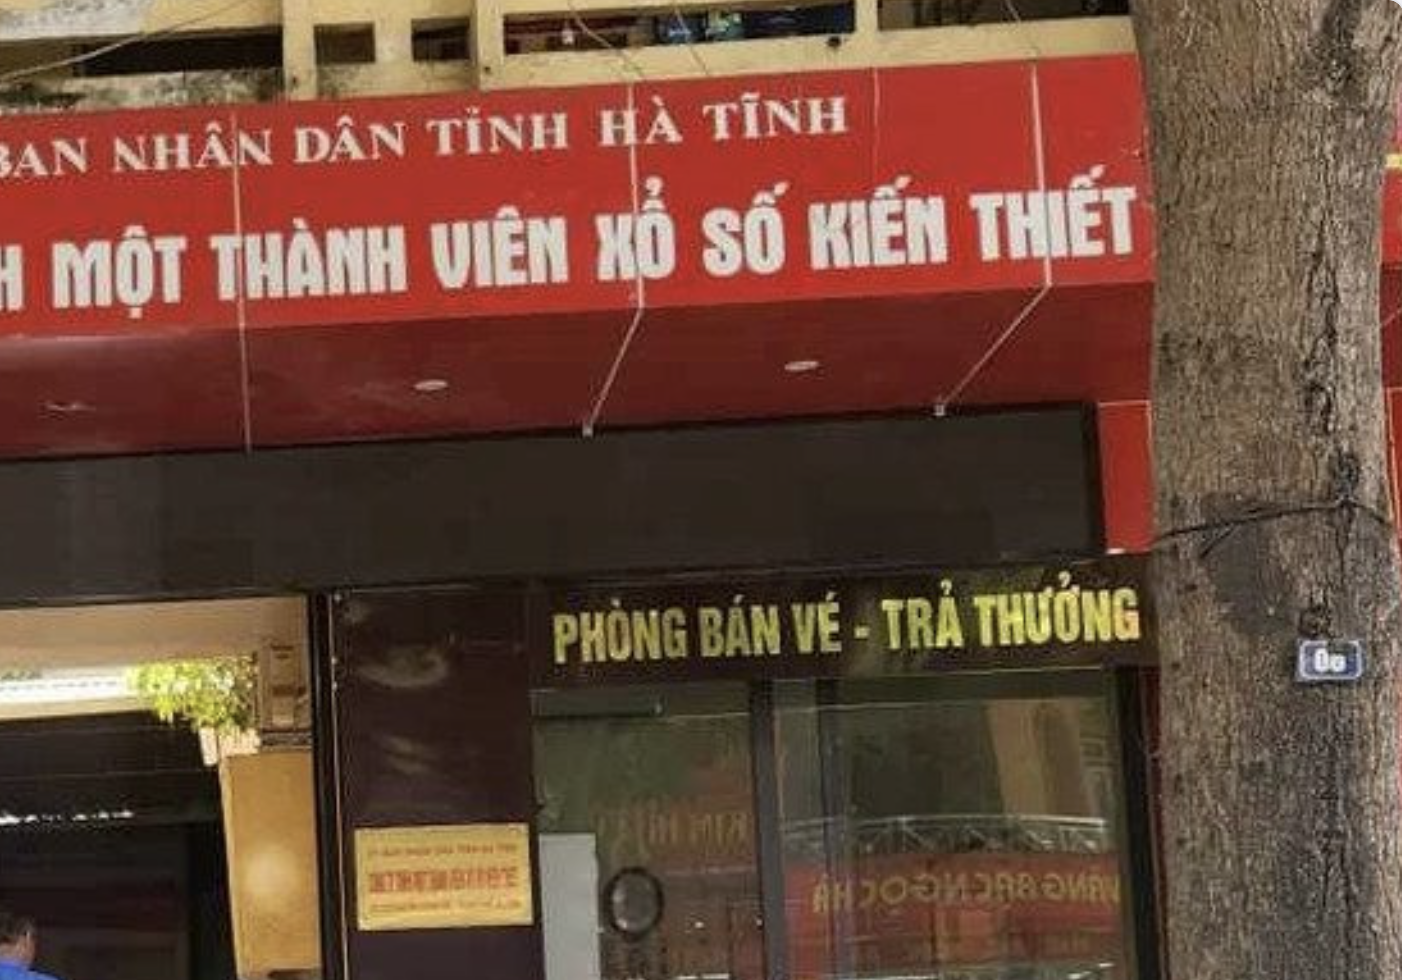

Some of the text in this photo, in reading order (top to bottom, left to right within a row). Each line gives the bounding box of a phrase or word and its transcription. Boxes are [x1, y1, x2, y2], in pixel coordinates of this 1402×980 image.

[113, 121, 272, 171] NHÂN
[295, 115, 406, 162] DÂN
[428, 107, 568, 155] TỈNH
[599, 96, 682, 146] HÀ
[704, 92, 849, 140] TĨNH
[52, 225, 188, 318] MỘT
[210, 218, 408, 299] THÀNH
[430, 206, 570, 288] VIÊN
[596, 176, 676, 280] XỔ
[702, 181, 788, 276] SỐ
[809, 176, 948, 269] KIẾN
[970, 165, 1136, 260] THIẾT
[554, 600, 687, 664] PHÒNG
[699, 595, 780, 656] BÁN
[793, 592, 842, 653] VÉ
[882, 580, 964, 649] TRẢ
[974, 572, 1140, 647] THƯỞNG
